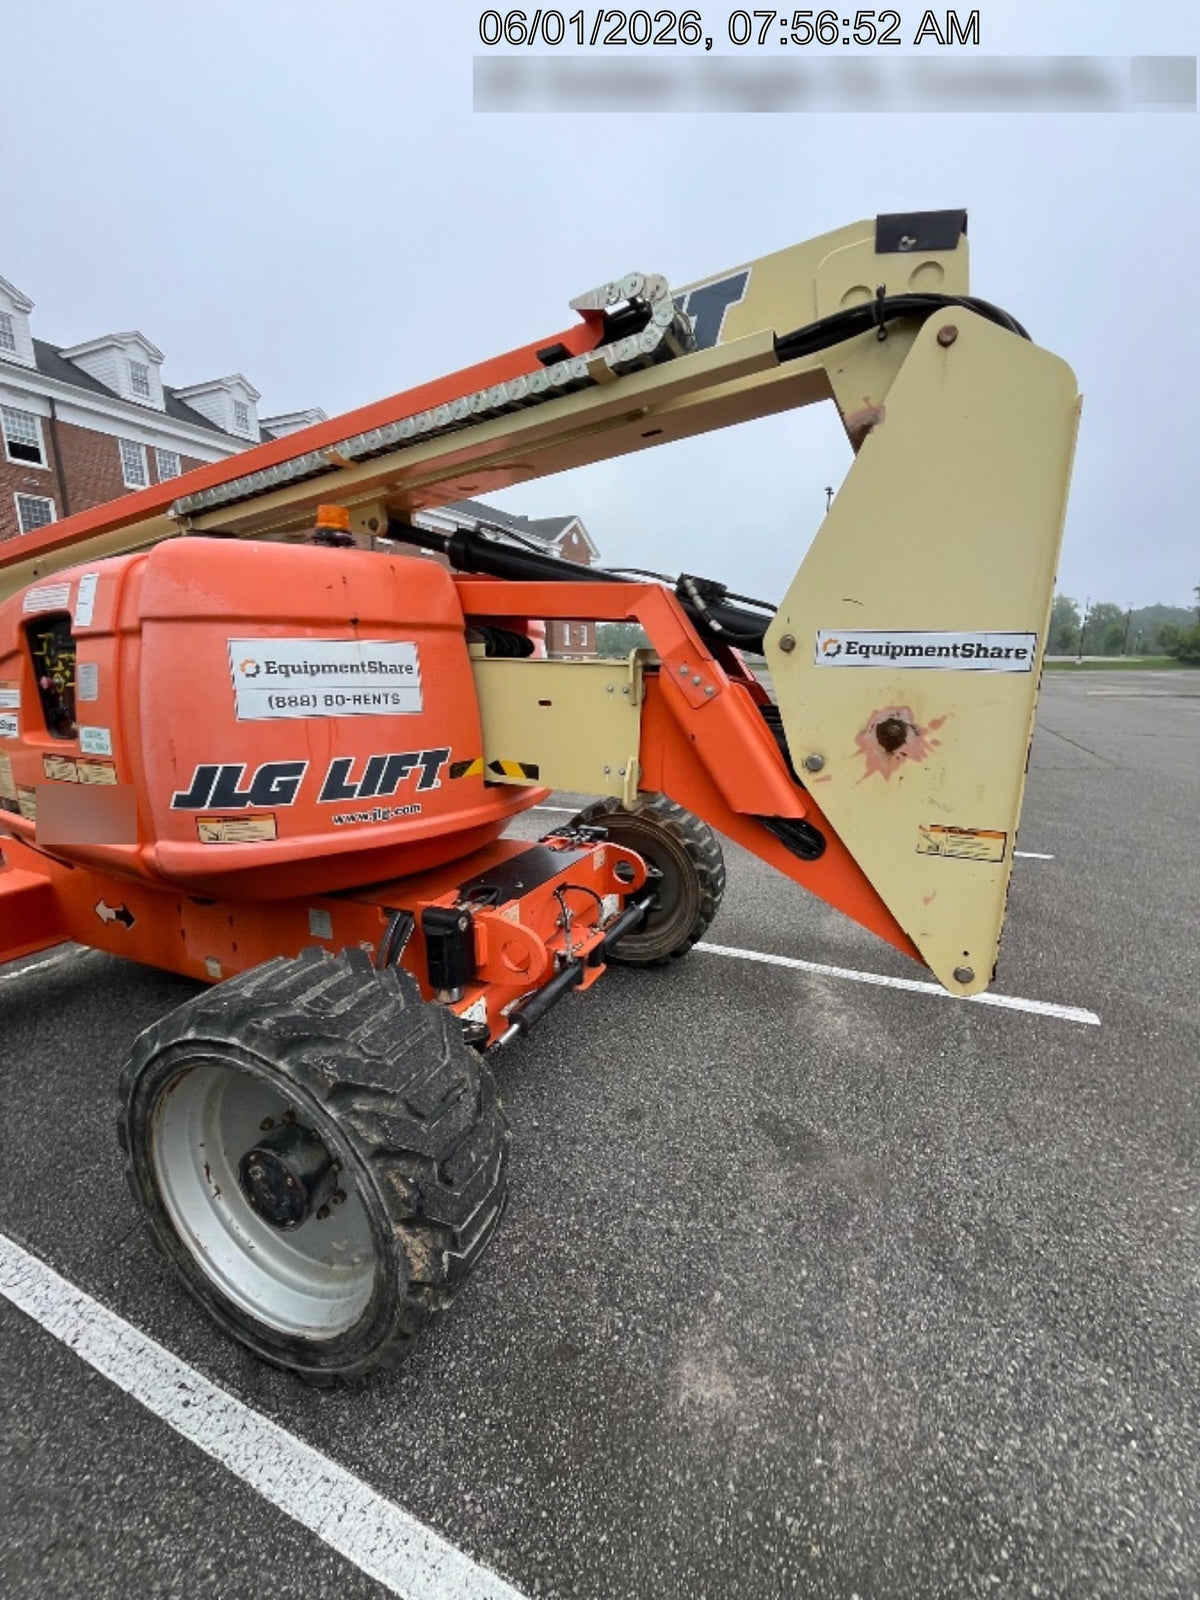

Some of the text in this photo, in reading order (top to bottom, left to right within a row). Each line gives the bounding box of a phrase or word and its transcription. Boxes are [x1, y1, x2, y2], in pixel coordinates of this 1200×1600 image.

[845, 641, 1029, 660] EquipmentShare
[264, 660, 413, 678] EquipmentShare
[267, 694, 318, 710] (888)
[170, 761, 310, 809] JLG
[316, 747, 452, 804] LIFT
[332, 803, 422, 825] www.jlg.com
